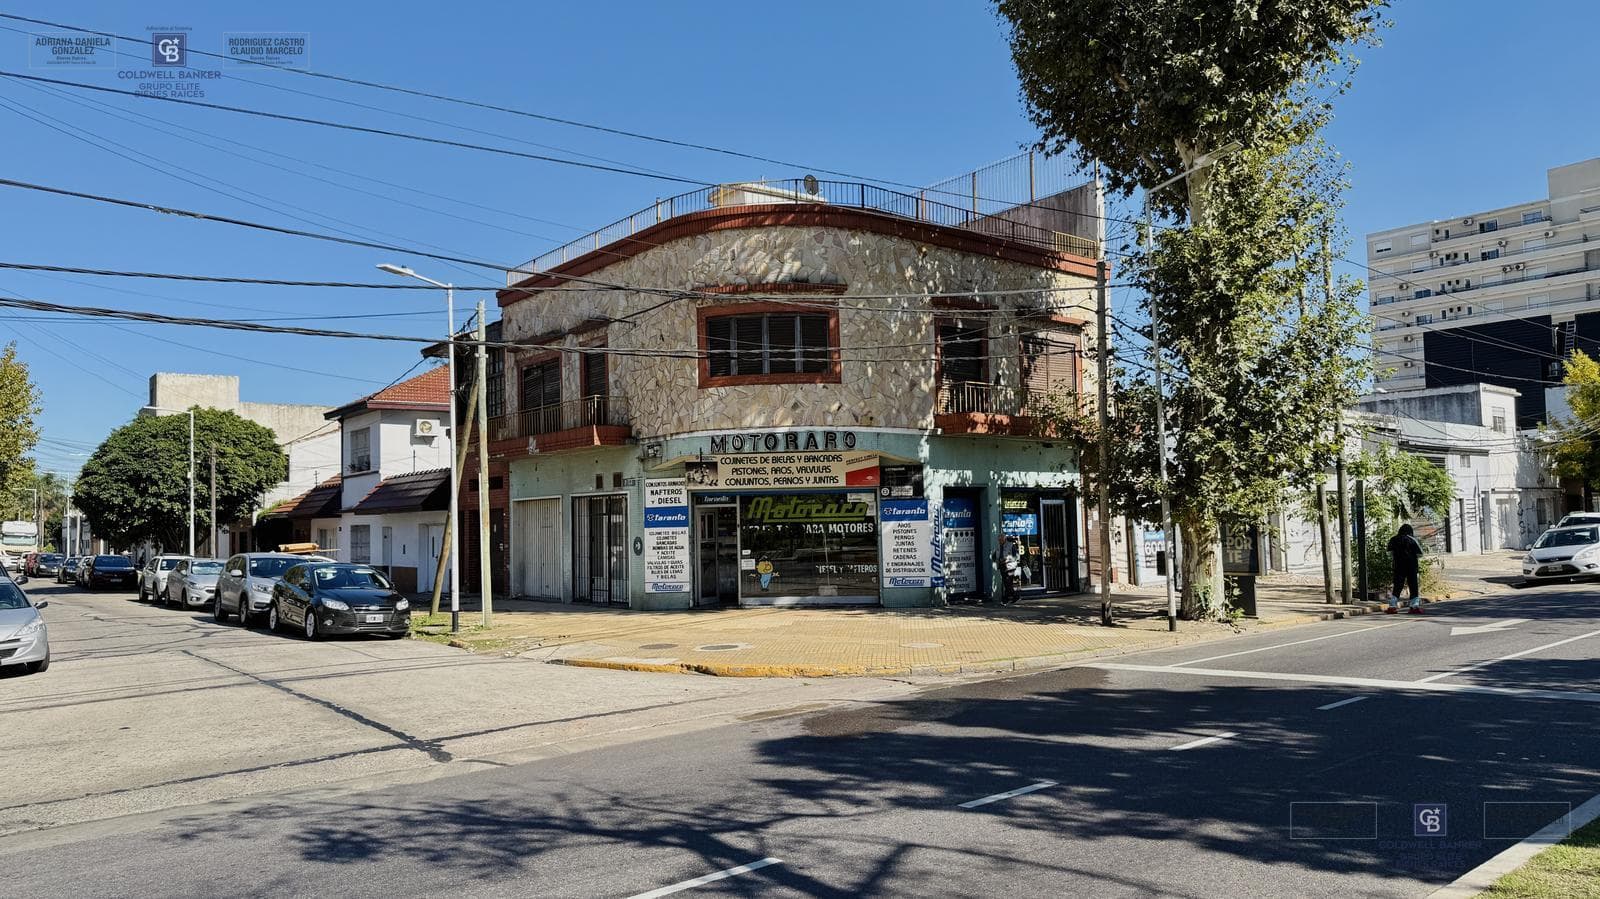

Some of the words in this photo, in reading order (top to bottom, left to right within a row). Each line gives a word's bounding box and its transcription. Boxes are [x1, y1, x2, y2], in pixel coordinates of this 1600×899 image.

[710, 430, 856, 452] MOTORARO
[720, 456, 758, 464] COJINETES
[760, 456, 769, 464] DE
[771, 456, 795, 464] BIELAS
[804, 454, 843, 463] BANCADAS
[732, 467, 769, 476] PISTONES,
[771, 466, 794, 475] AROS,
[796, 465, 831, 474] VALVULAS
[725, 478, 771, 486] CONJUNTOS,
[892, 507, 926, 515] taranto
[802, 524, 824, 534] ARA
[828, 523, 874, 534] MOTORES
